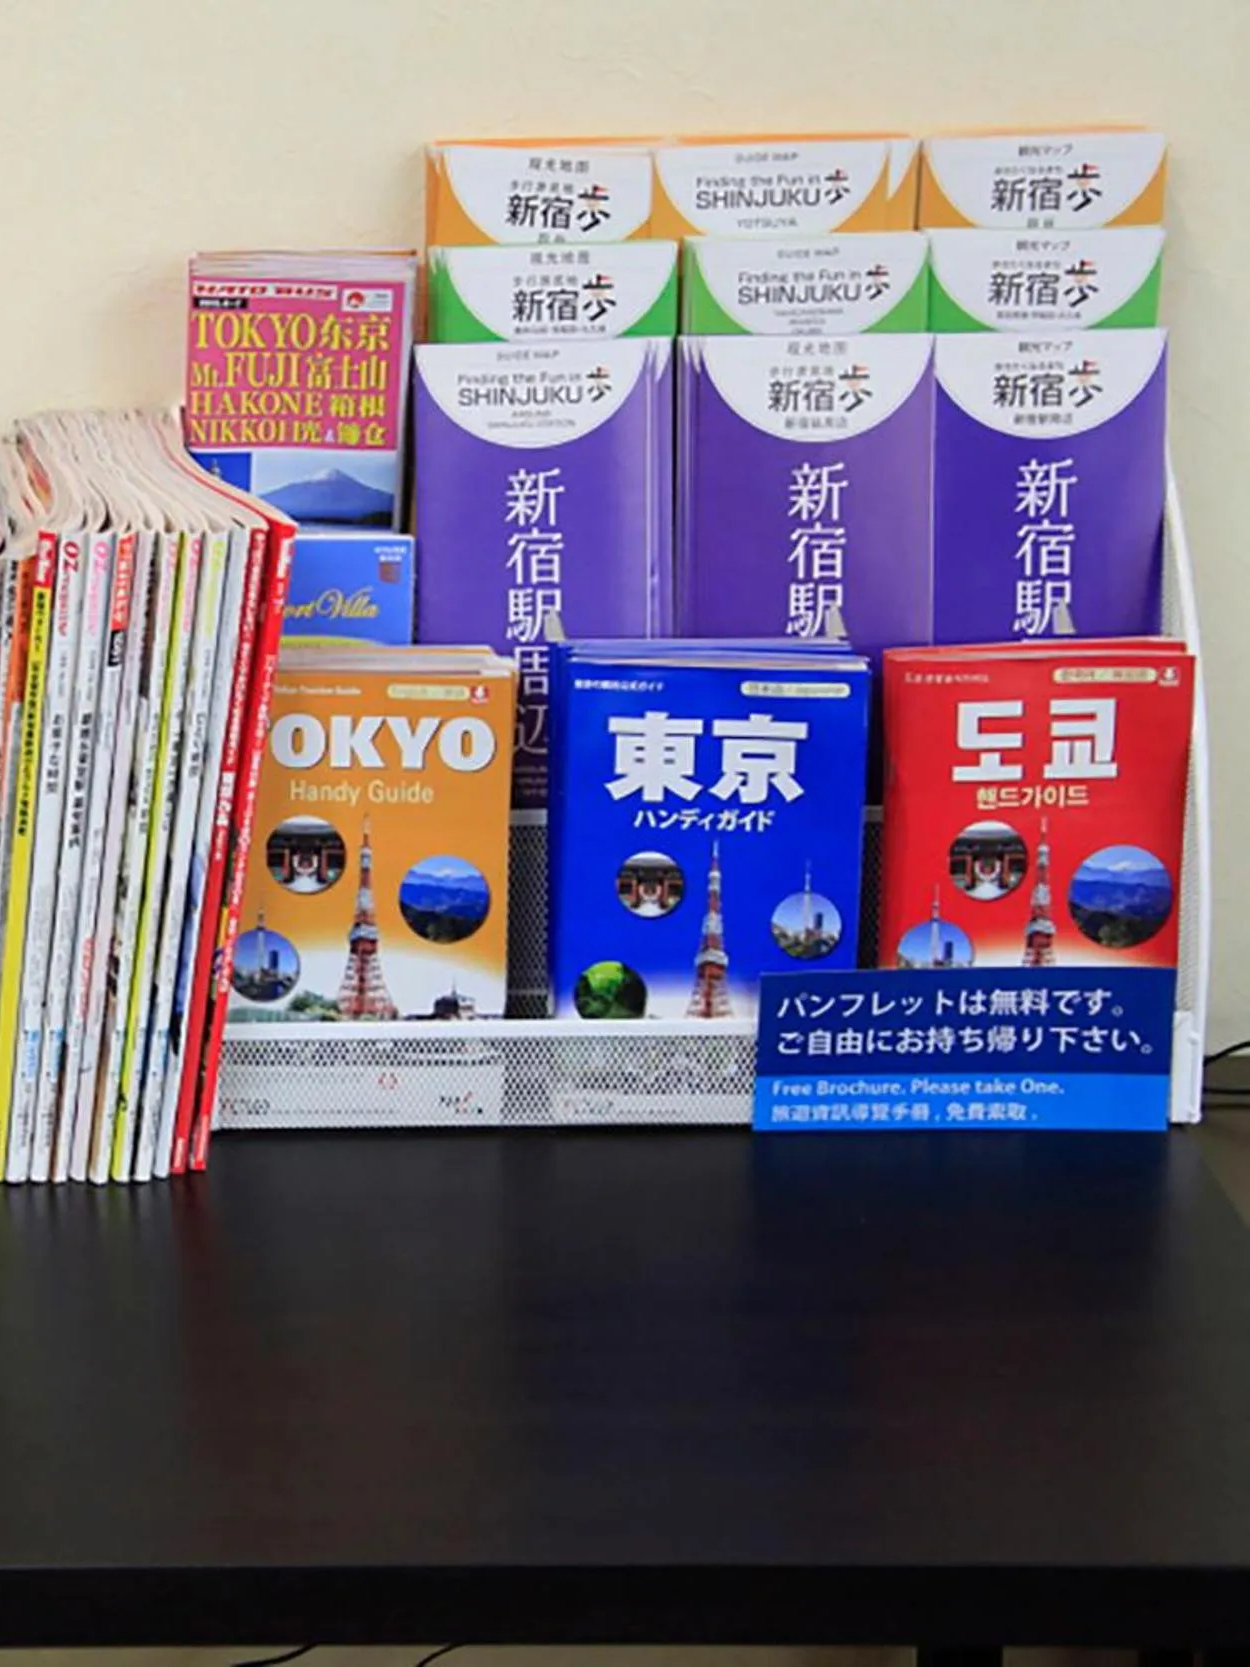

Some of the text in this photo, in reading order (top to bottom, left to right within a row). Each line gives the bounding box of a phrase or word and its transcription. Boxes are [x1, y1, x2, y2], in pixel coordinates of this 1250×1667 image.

[695, 174, 820, 189] Finding the Fun in
[695, 188, 821, 210] SHINJUKU
[737, 268, 862, 284] Finding the Fun in
[737, 283, 862, 305] SHINJUKU
[191, 312, 316, 350] TOKYO
[225, 351, 301, 387] FUJI
[457, 371, 582, 388] Finding the Fun in
[190, 391, 324, 417] HAKONE
[457, 385, 583, 407] SHINJUKU
[786, 461, 849, 638] 新宿駅
[1013, 458, 1078, 635] 新宿駅
[266, 713, 497, 773] OKYO
[952, 697, 1119, 781] 도쿄
[603, 710, 809, 804] 東京
[290, 779, 434, 806] Handy Guide
[976, 785, 1089, 810] 핸드가이드
[633, 808, 776, 832] ハンディガイド
[777, 987, 1124, 1018] パンフレットは無料です。
[777, 1025, 1153, 1056] ご自由にお持ち帰り下さい。
[772, 1078, 1065, 1097] Free Brochure. Please take One.
